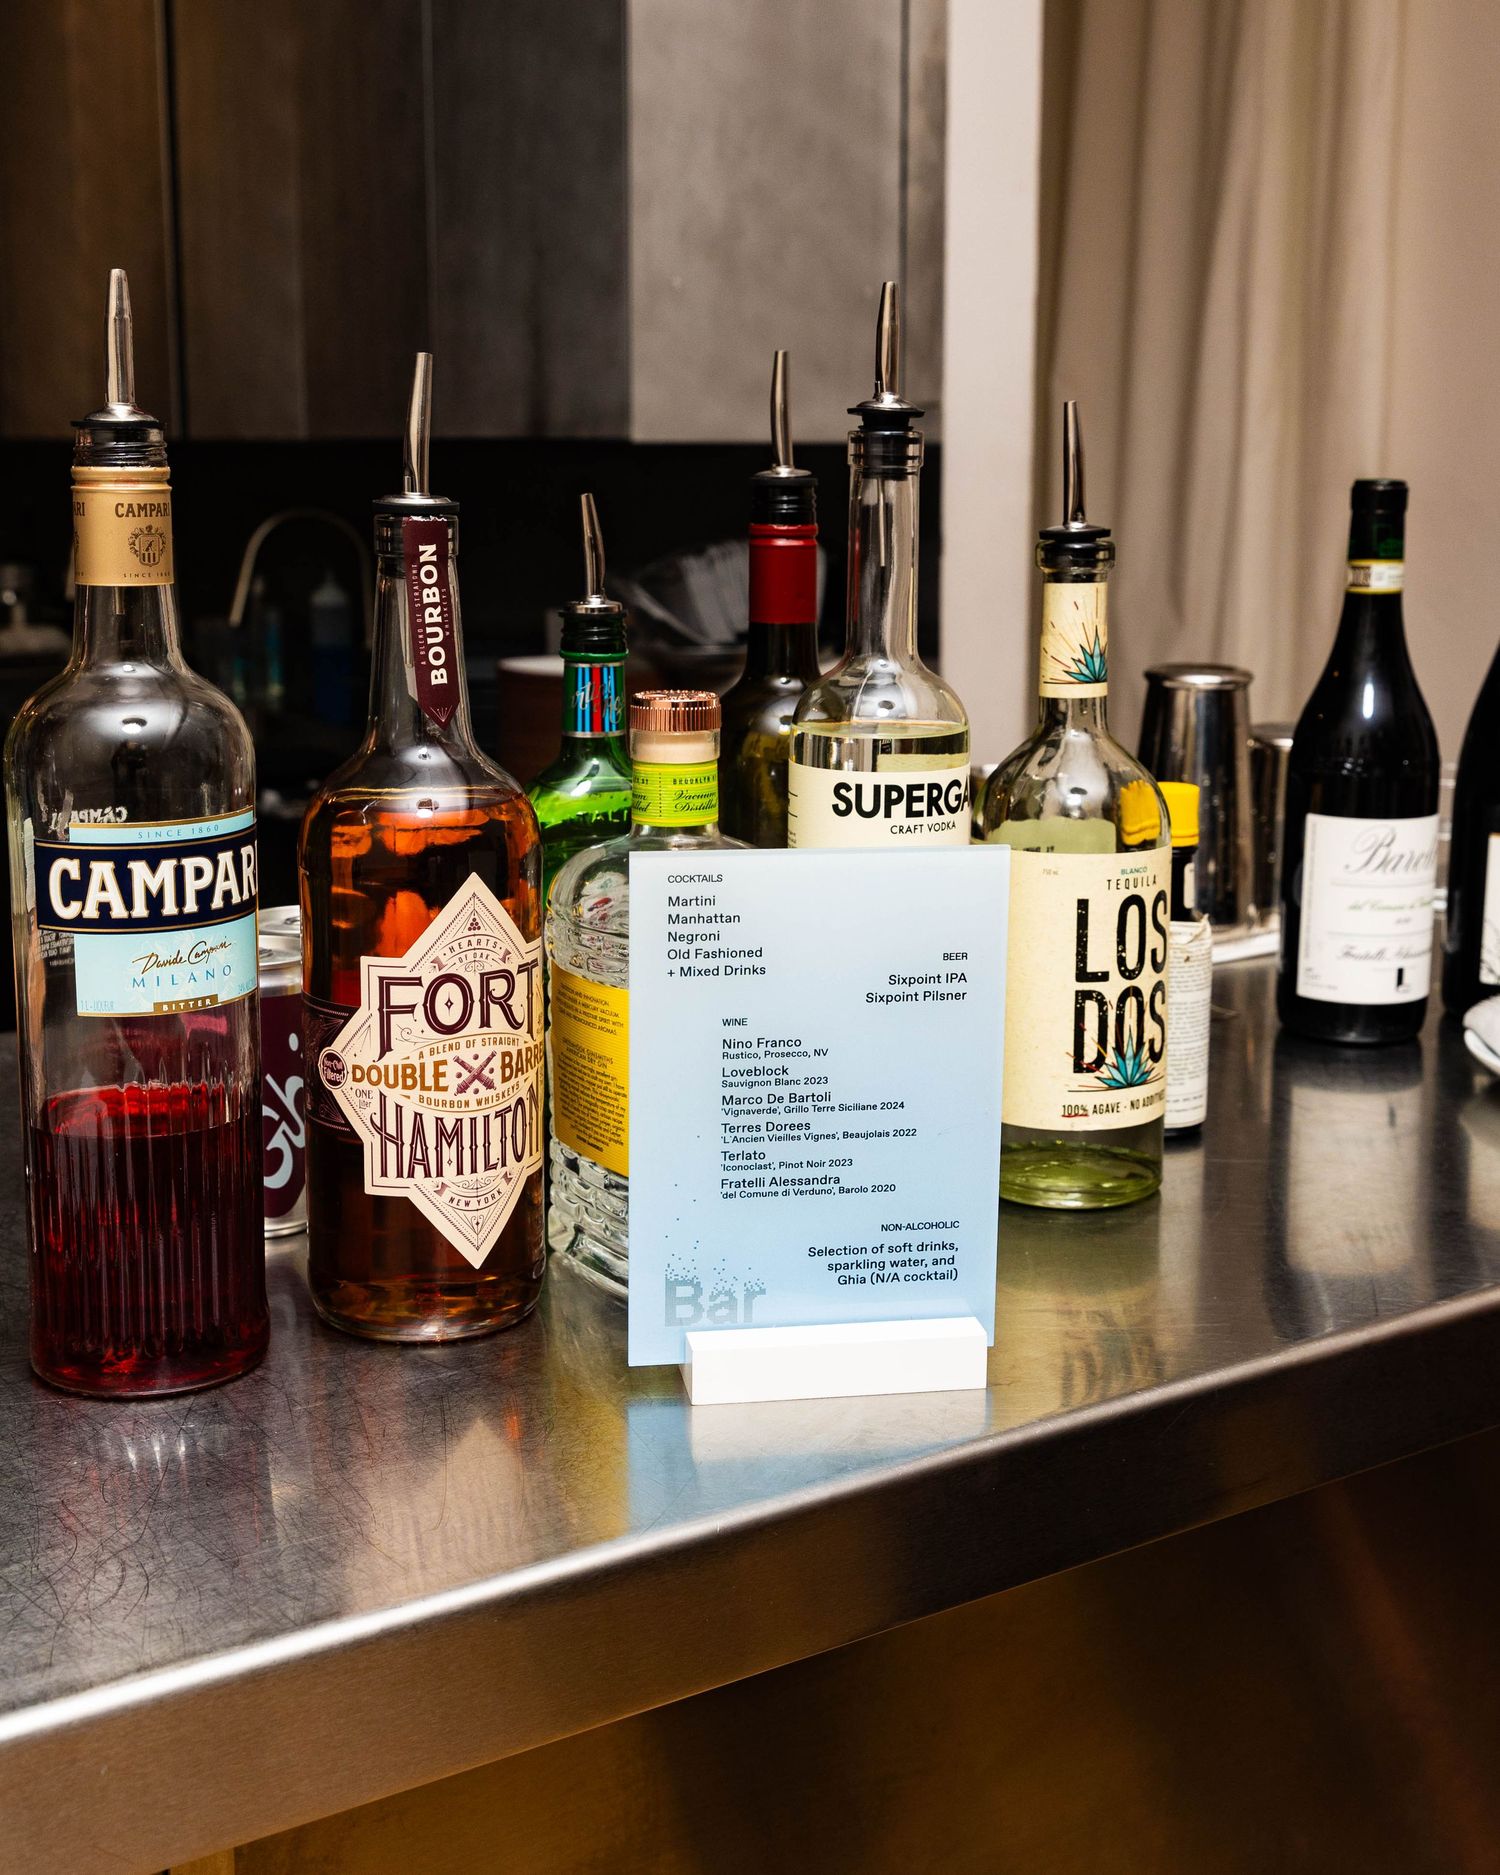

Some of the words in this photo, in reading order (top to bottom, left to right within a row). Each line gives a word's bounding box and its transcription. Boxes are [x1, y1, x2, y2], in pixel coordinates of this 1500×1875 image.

[418, 543, 448, 686] BOURBON
[832, 775, 970, 819] SUPERGA
[138, 828, 182, 840] SINCE
[191, 824, 220, 836] 1860
[890, 823, 924, 835] CRAFT
[927, 820, 957, 833] VODKA
[1121, 866, 1148, 875] BLANCO
[667, 874, 723, 884] COCKTAILS
[1106, 874, 1157, 891] TEQUILA
[668, 895, 716, 907] Martini
[668, 913, 741, 925] Manhattan
[668, 930, 721, 945] Negroni
[1075, 889, 1168, 983] LOS
[449, 938, 498, 954] HEARTS
[667, 948, 691, 960] Old
[694, 947, 763, 960] Fashioned
[458, 954, 470, 963] OF
[473, 952, 490, 962] OAK
[942, 952, 968, 961] BEER
[132, 964, 232, 989] MILANO
[679, 965, 720, 977] Mixed
[724, 964, 767, 976] Drinks
[888, 973, 942, 987] Sixpoint
[945, 972, 968, 984] IPA
[162, 998, 212, 1012] BITTER
[865, 991, 919, 1005] Sixpoint
[923, 990, 967, 1001] Pilsner
[374, 957, 539, 1062] FORT
[722, 1018, 748, 1027] WINE
[1073, 980, 1166, 1074] DOS
[418, 1051, 425, 1060] A
[429, 1040, 461, 1057] BLEND
[465, 1039, 476, 1049] OF
[481, 1037, 520, 1048] STRAIGHT
[722, 1038, 753, 1050] Nino
[756, 1037, 802, 1049] Franco
[722, 1051, 761, 1060] Rustico,
[764, 1050, 811, 1059] Prosecco,
[813, 1048, 829, 1057] NV
[351, 1060, 449, 1093] DOUBLE
[722, 1065, 789, 1077] Loveblock
[721, 1079, 772, 1090] Sauvignon
[774, 1077, 801, 1087] Blanc
[803, 1076, 829, 1085] 2023
[355, 1089, 374, 1100] ONE
[418, 1094, 470, 1109] BOURBON
[475, 1083, 521, 1106] WHISKEYS
[722, 1094, 763, 1106] Marco
[767, 1093, 785, 1104] De
[788, 1091, 832, 1103] Bartoli
[721, 1106, 781, 1117] 'Vignaverde',
[783, 1105, 809, 1114] Grillo
[811, 1104, 836, 1113] Terre
[838, 1102, 878, 1112] Siciliane
[880, 1101, 905, 1110] 2024
[1062, 1104, 1087, 1116] 100%
[1092, 1101, 1120, 1115] AGAVE
[1130, 1099, 1140, 1111] NO
[370, 1068, 540, 1179] HAMILTON
[721, 1122, 762, 1134] Terres
[765, 1121, 811, 1132] Dorees
[767, 1133, 802, 1142] Vieilles
[804, 1132, 840, 1143] Vignes',
[842, 1129, 890, 1141] Beaujolais
[892, 1128, 917, 1137] 2022
[721, 1150, 766, 1161] Terlato
[779, 1160, 804, 1170] Pinot
[806, 1159, 827, 1169] Noir
[828, 1158, 853, 1168] 2023
[721, 1177, 766, 1189] Fratelli
[769, 1174, 841, 1187] Alessandra
[449, 1195, 471, 1208] NEW
[476, 1188, 504, 1207] YORK
[739, 1189, 779, 1199] Comune
[781, 1188, 790, 1197] di
[792, 1187, 836, 1197] Verduno',
[838, 1185, 869, 1194] Barolo
[871, 1184, 896, 1193] 2020
[881, 1220, 960, 1232] NON-ALCOHOLIC
[808, 1245, 868, 1257] Selection
[871, 1244, 885, 1255] of
[887, 1242, 913, 1254] soft
[916, 1240, 959, 1253] drinks,
[827, 1259, 886, 1273] sparkling
[889, 1257, 928, 1269] water,
[931, 1255, 955, 1266] and
[837, 1274, 867, 1285] Ghia
[870, 1272, 900, 1285] (N/A
[903, 1268, 958, 1282] cocktail)
[664, 1275, 766, 1328] Bar
